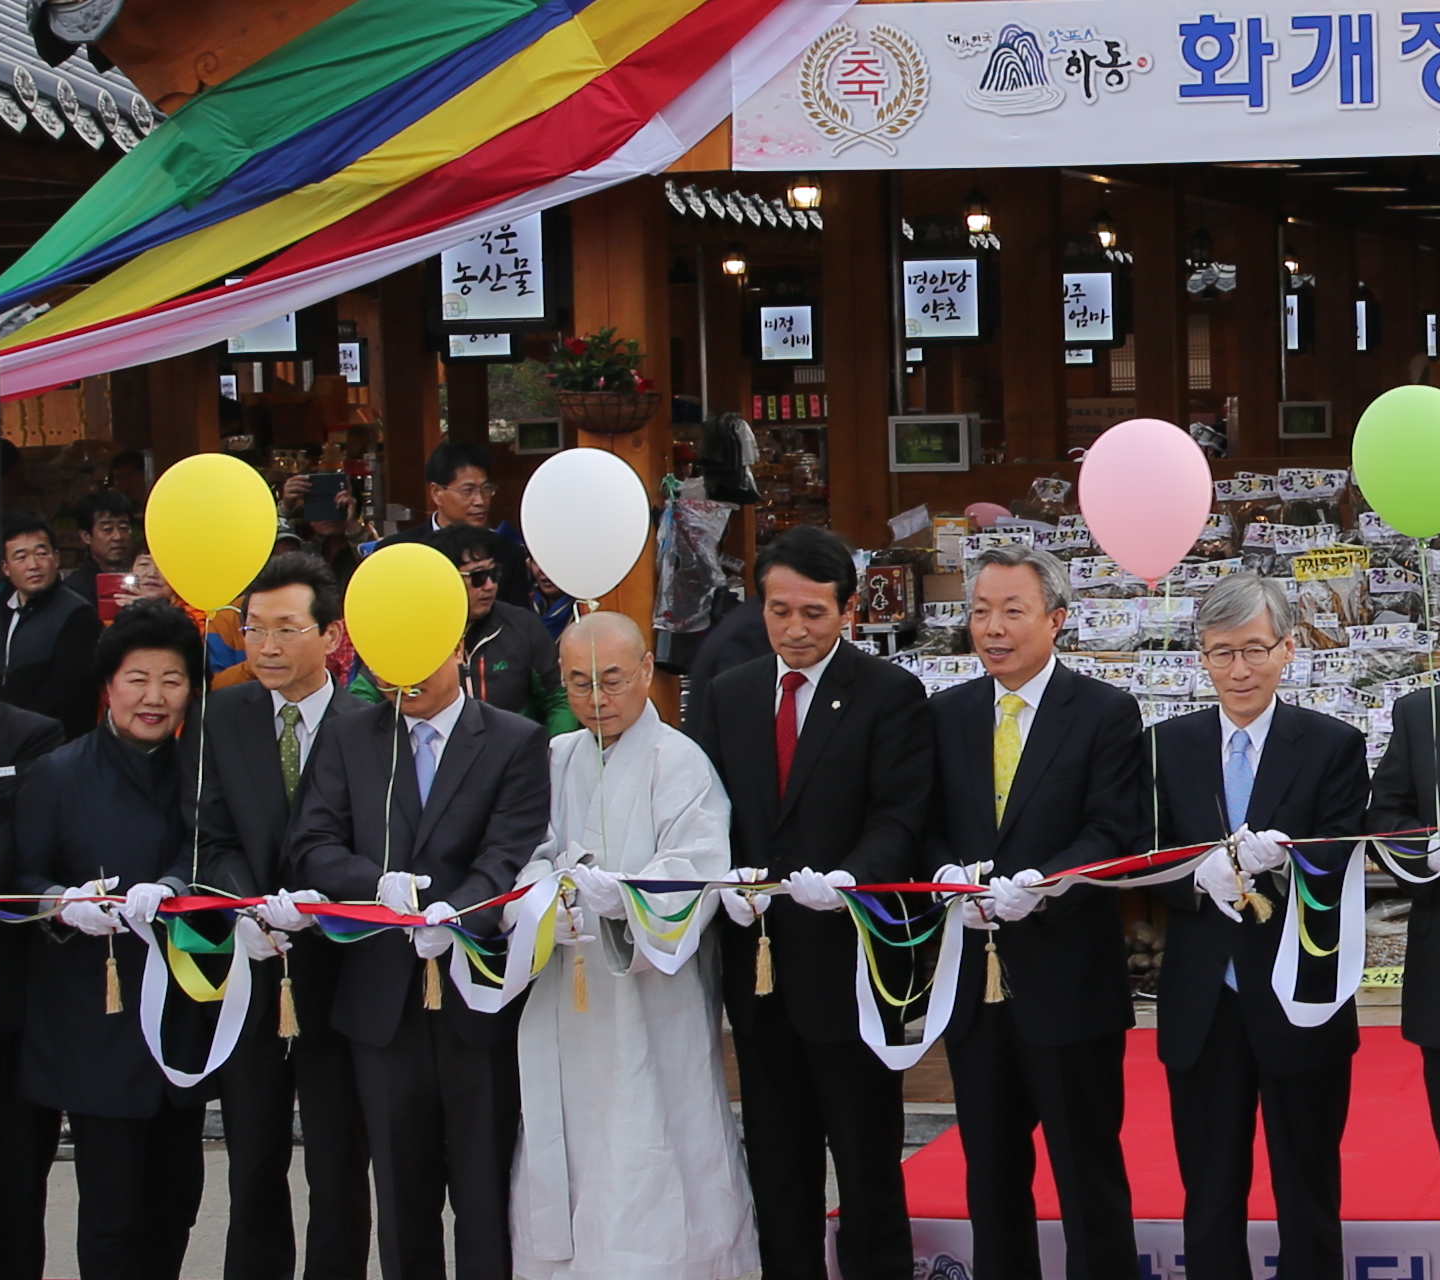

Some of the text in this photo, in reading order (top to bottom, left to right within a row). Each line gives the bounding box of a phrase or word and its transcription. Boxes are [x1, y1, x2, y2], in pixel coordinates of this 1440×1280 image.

[837, 50, 886, 107] 축
[1065, 40, 1133, 99] 하동
[451, 257, 536, 297] 농산물
[907, 269, 972, 294] 명인당
[921, 297, 962, 322] 약초
[1068, 304, 1110, 328] 엄마
[764, 316, 794, 333] 미정
[782, 334, 810, 348] 이네
